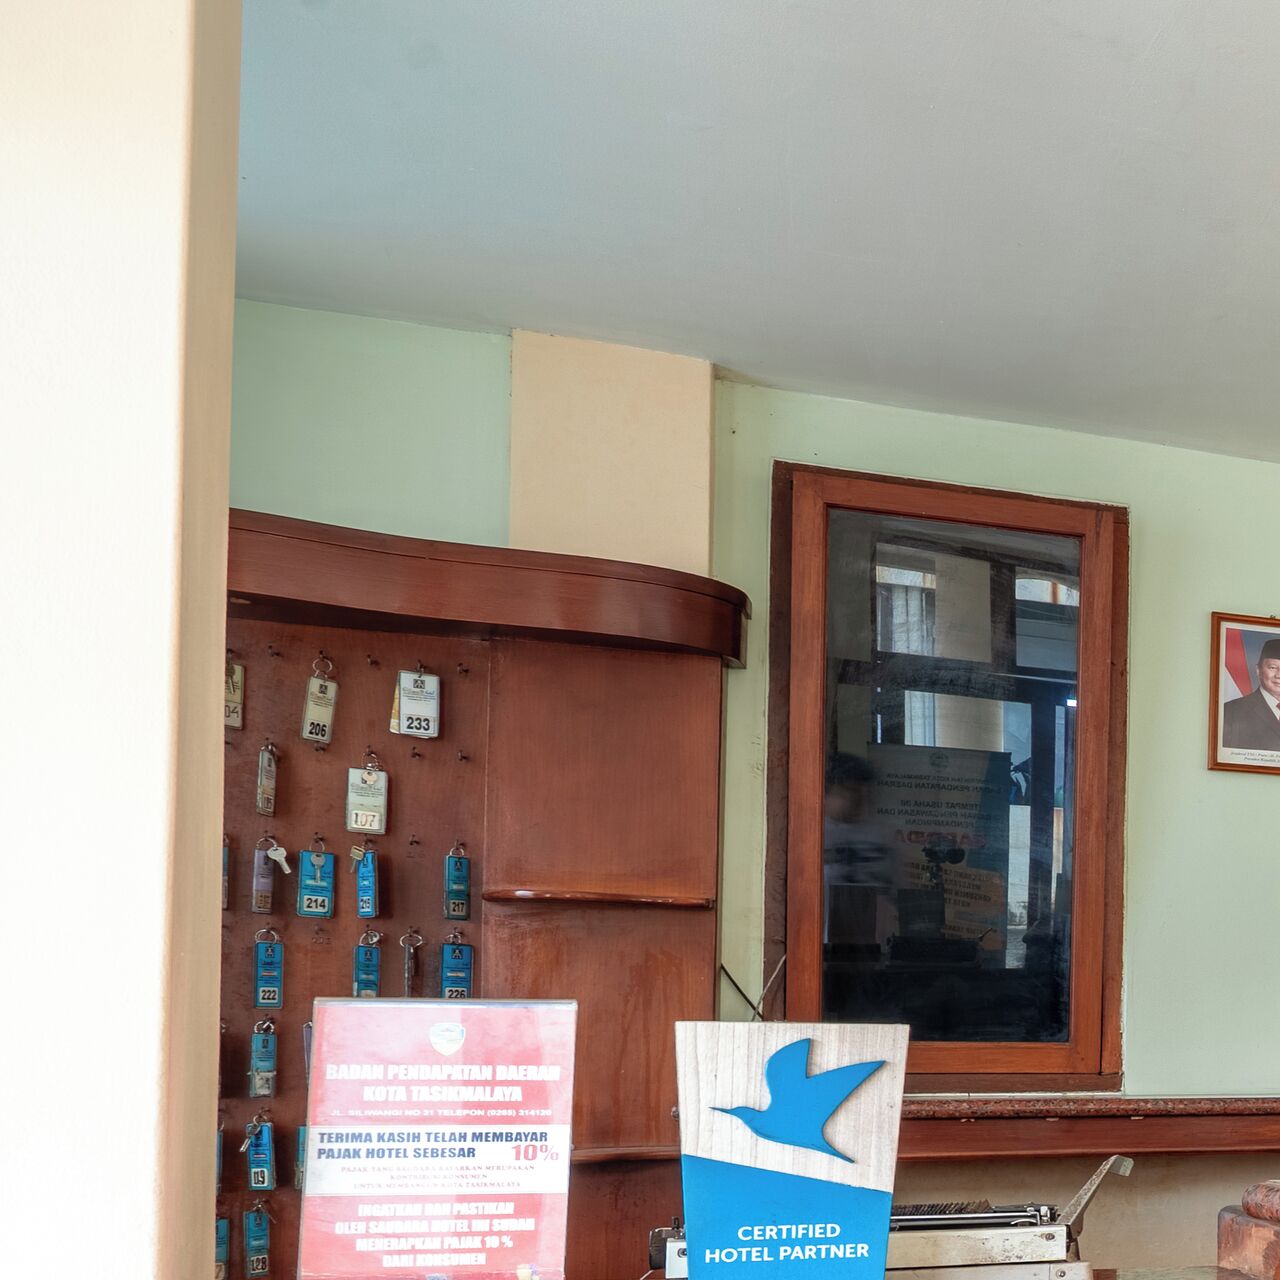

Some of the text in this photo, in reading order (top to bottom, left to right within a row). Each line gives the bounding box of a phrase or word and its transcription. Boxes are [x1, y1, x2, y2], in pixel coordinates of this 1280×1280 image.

[308, 722, 327, 738] 206
[406, 717, 430, 731] 233
[354, 812, 376, 828] 107
[306, 898, 326, 910] 214
[452, 902, 465, 912] 217
[261, 990, 277, 1001] 222
[448, 989, 466, 999] 226
[326, 1064, 561, 1080] BADAN PENDAPATAN DAERAH
[363, 1086, 523, 1102] KOTA TASIKMALAYA
[318, 1131, 548, 1143] TERIMA KASIH TELAH MEMBAYAR
[317, 1144, 559, 1161] PAJAK HOTEL SEBESAR 10%
[358, 1202, 514, 1216] INGATKAN DAN PASTIKAN
[335, 1218, 535, 1234] OLEH SAUDARA HOTEL INI SUDAH
[737, 1223, 841, 1241] CERTIFIED
[356, 1237, 442, 1251] MENERAPKAN
[443, 1236, 482, 1249] PAJAK
[484, 1236, 499, 1248] 10
[383, 1253, 486, 1267] DARI KONSUMEN
[705, 1243, 870, 1263] HOTEL PARTNER
